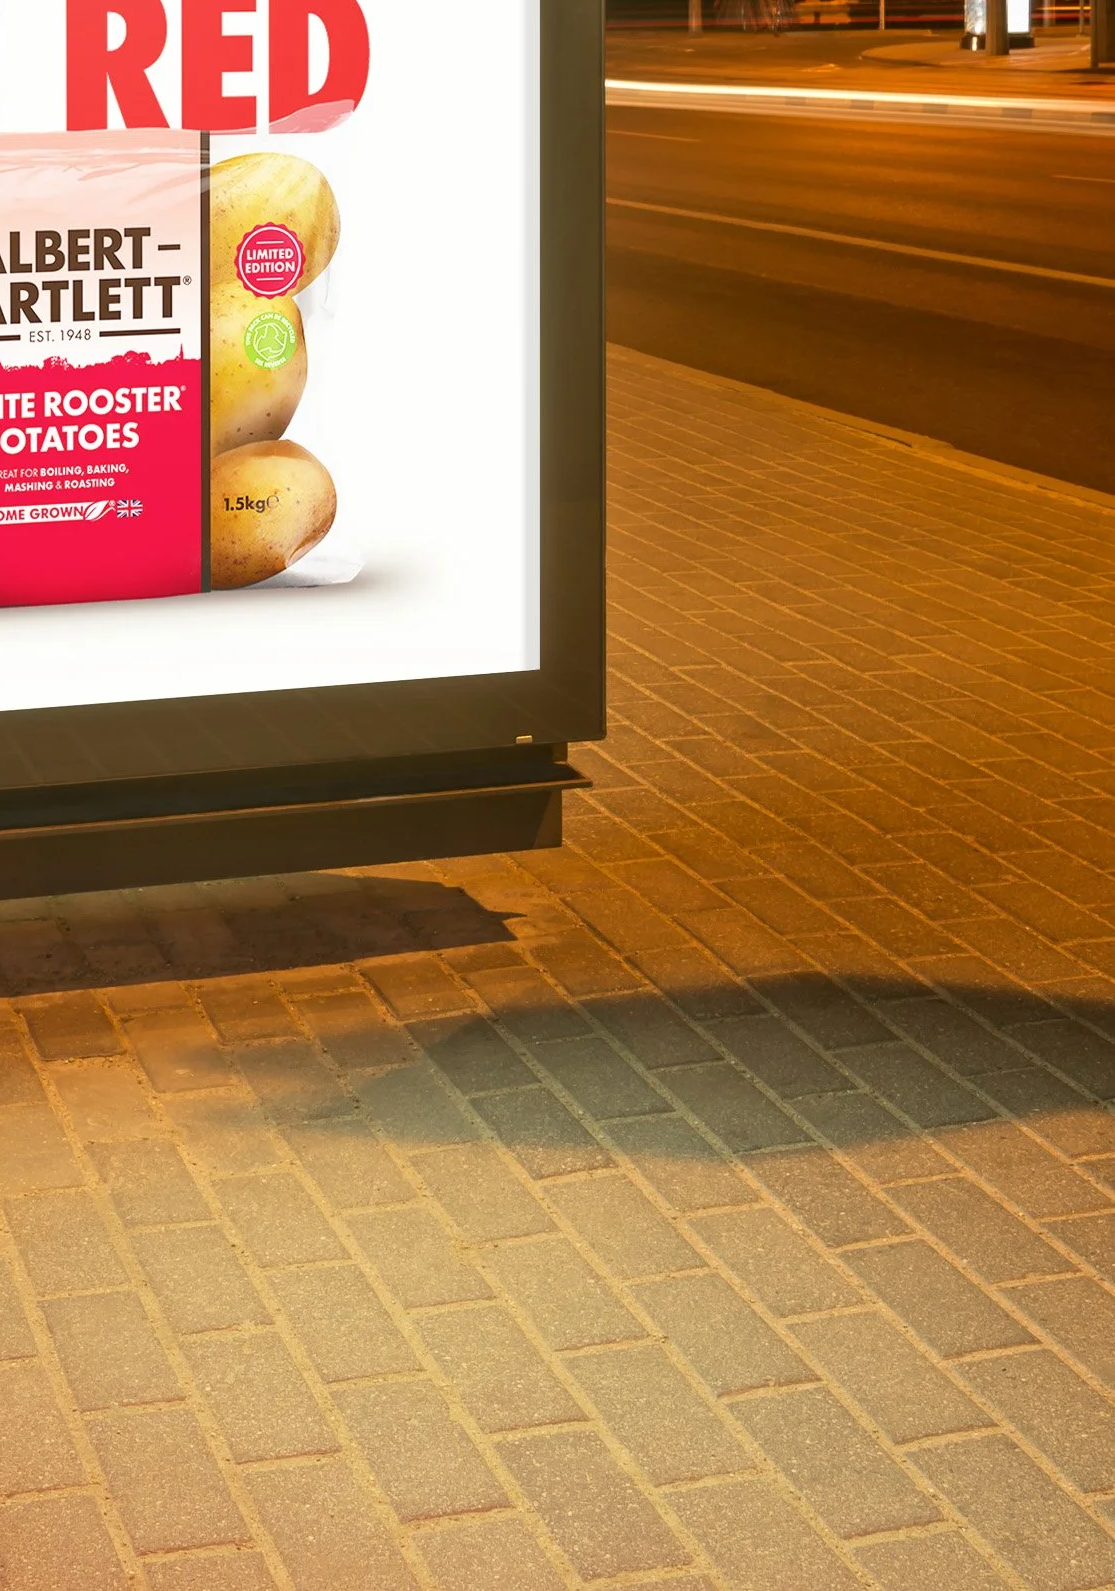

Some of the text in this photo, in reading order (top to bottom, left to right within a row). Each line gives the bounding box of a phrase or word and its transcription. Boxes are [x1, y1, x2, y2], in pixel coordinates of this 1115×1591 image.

[246, 248, 294, 260] LIMITED
[245, 261, 296, 274] EDITION
[29, 328, 92, 343] EST. 1948
[20, 467, 38, 478] FOR
[40, 465, 85, 477] BOILING,
[87, 463, 130, 474] BAKING,
[4, 481, 53, 492] MASHING
[64, 478, 116, 489] ROASTING
[29, 506, 84, 519] GROWN
